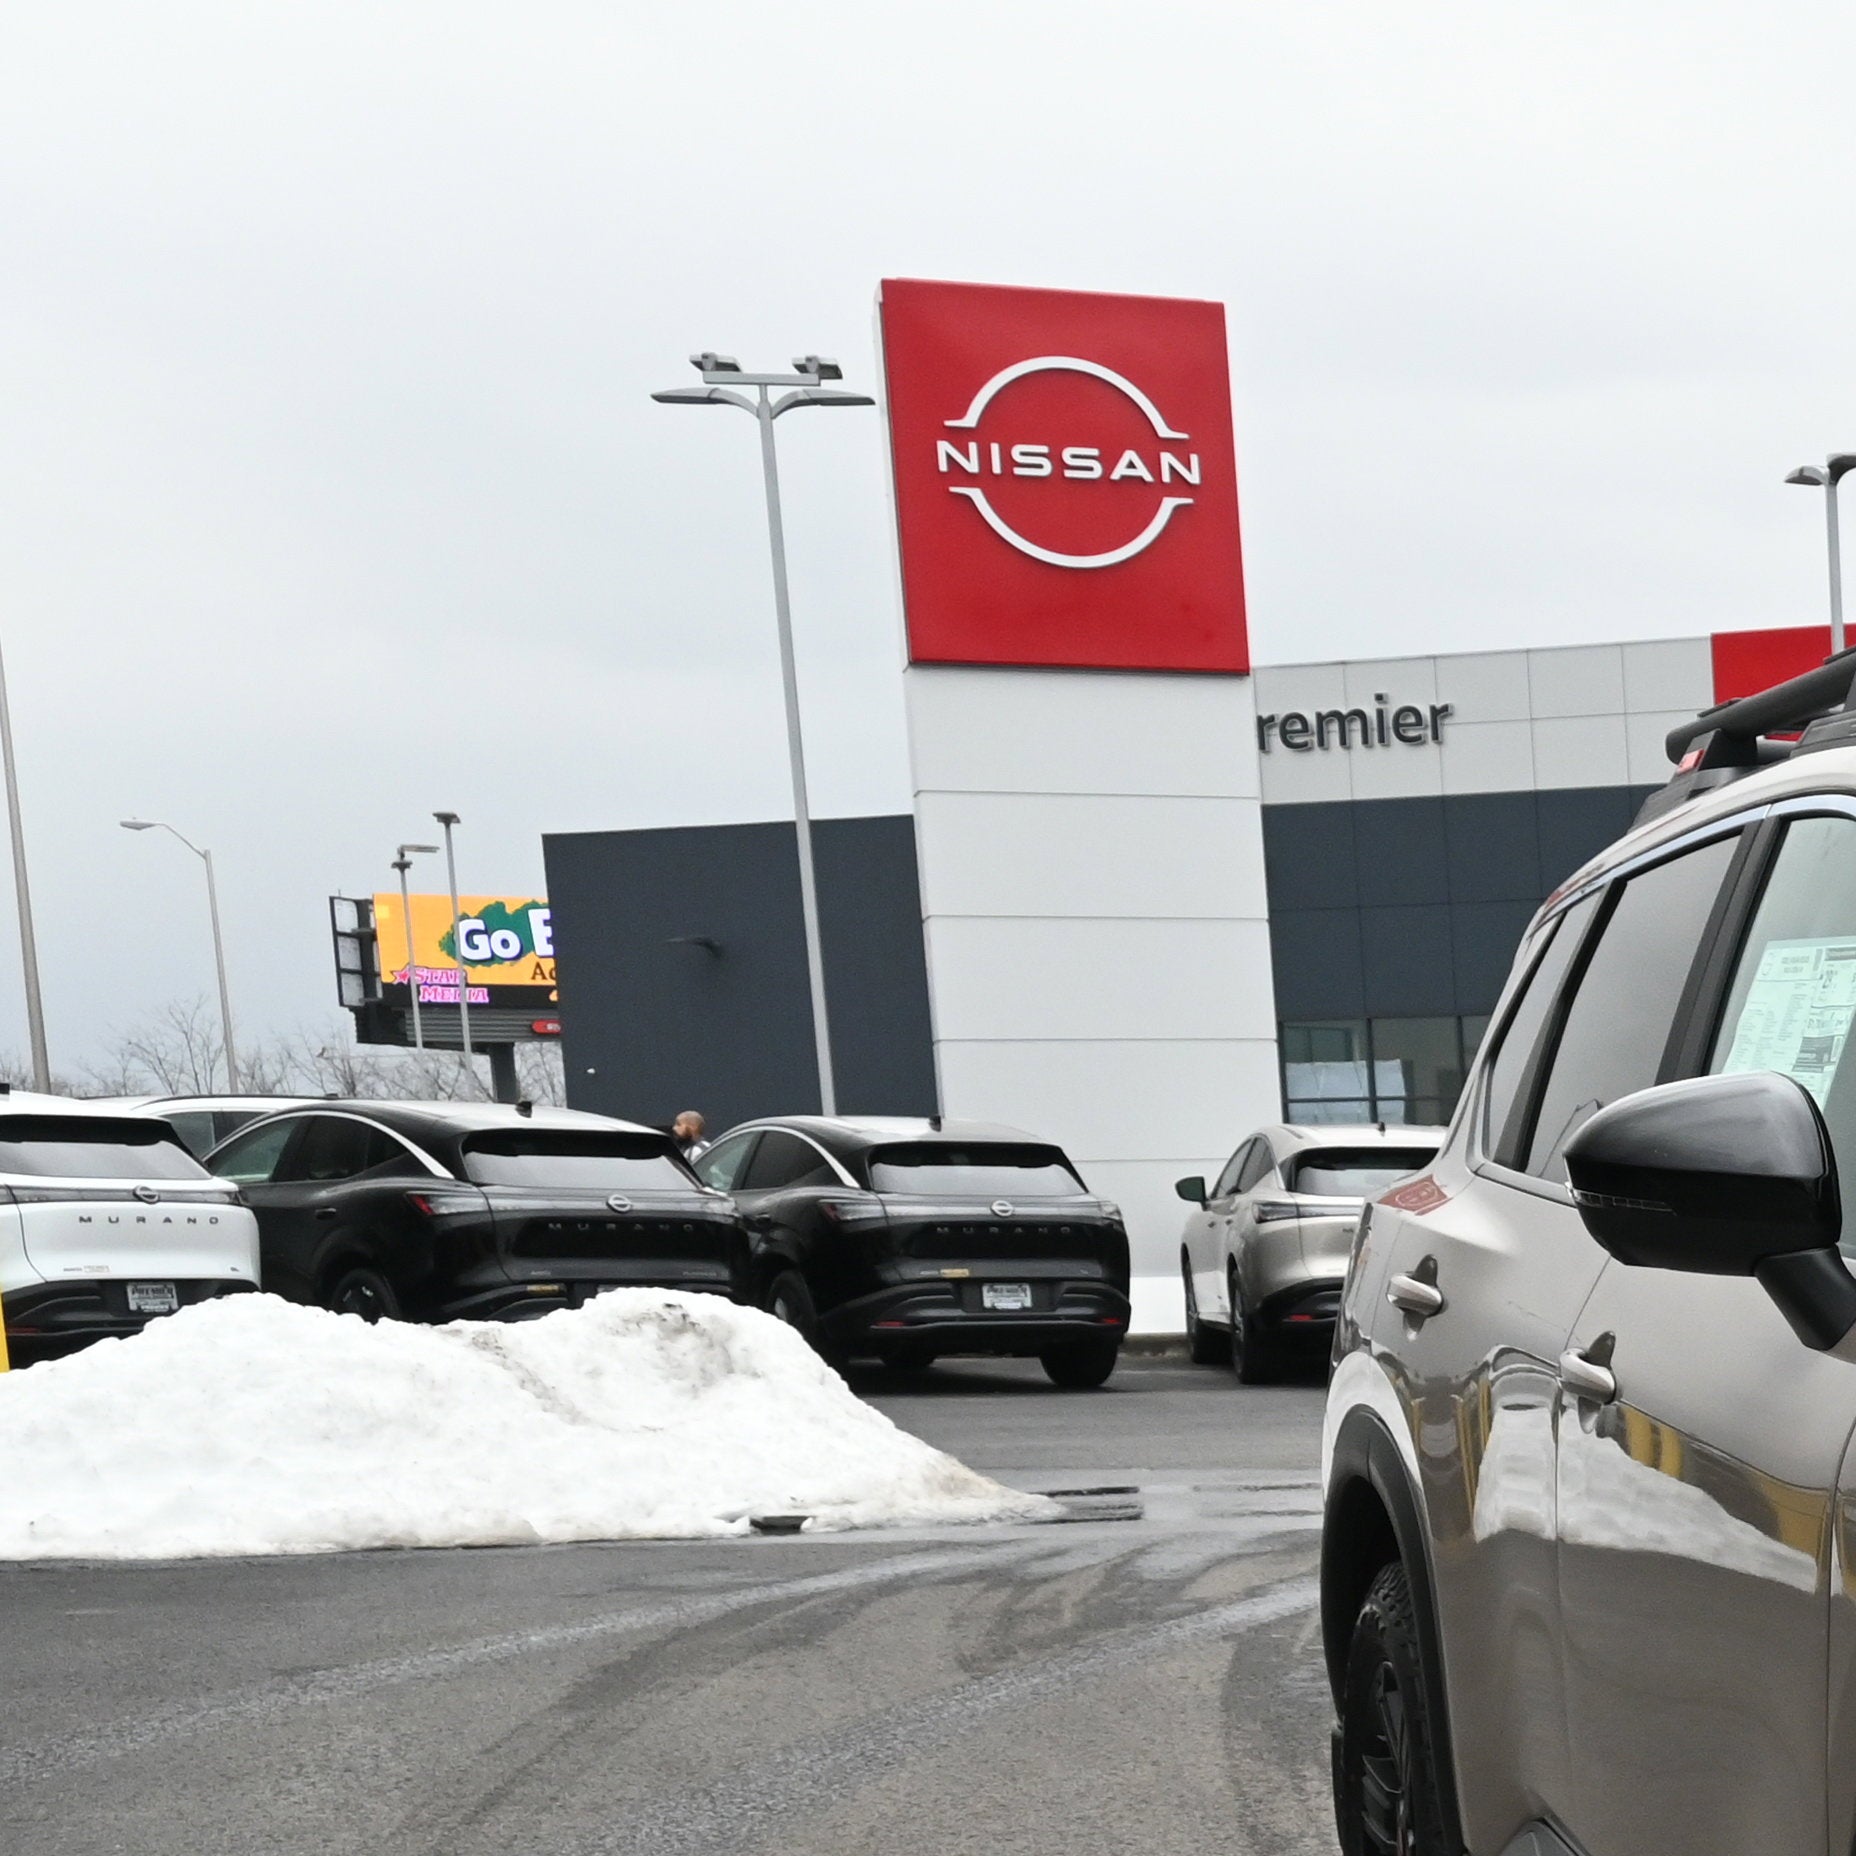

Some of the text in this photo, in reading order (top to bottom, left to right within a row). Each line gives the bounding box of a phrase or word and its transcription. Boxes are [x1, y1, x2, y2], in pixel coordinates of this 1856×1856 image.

[936, 440, 1201, 485] NISSAN
[457, 918, 523, 961] Go
[78, 1215, 219, 1225] MURANO
[547, 1222, 694, 1231] MURANO
[936, 1226, 1071, 1234] MURANO
